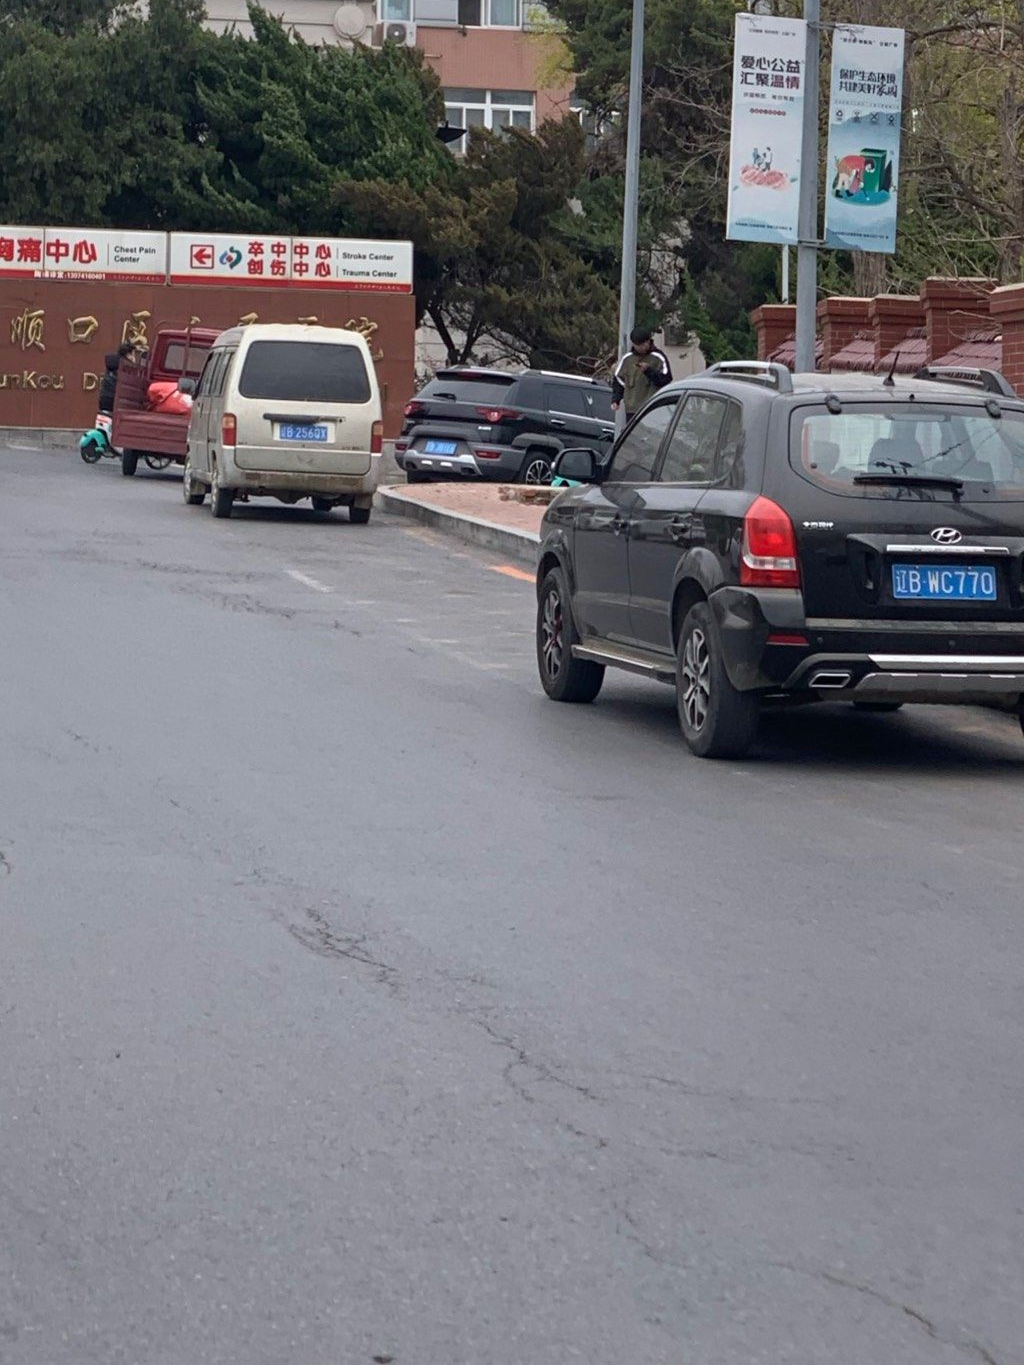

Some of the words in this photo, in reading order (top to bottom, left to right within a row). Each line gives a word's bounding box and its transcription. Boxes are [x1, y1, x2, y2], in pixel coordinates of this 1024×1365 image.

[741, 55, 801, 74] 爱心公益
[740, 71, 800, 90] 汇聚温情
[114, 245, 137, 255] Chest
[139, 246, 156, 255] Pain
[247, 241, 331, 260] 卒中中心
[342, 251, 367, 260] Stroke
[369, 252, 394, 261] Center
[114, 255, 140, 264] Center
[247, 259, 331, 278] 创伤中心
[342, 268, 370, 277] Trauma
[371, 269, 397, 278] Center
